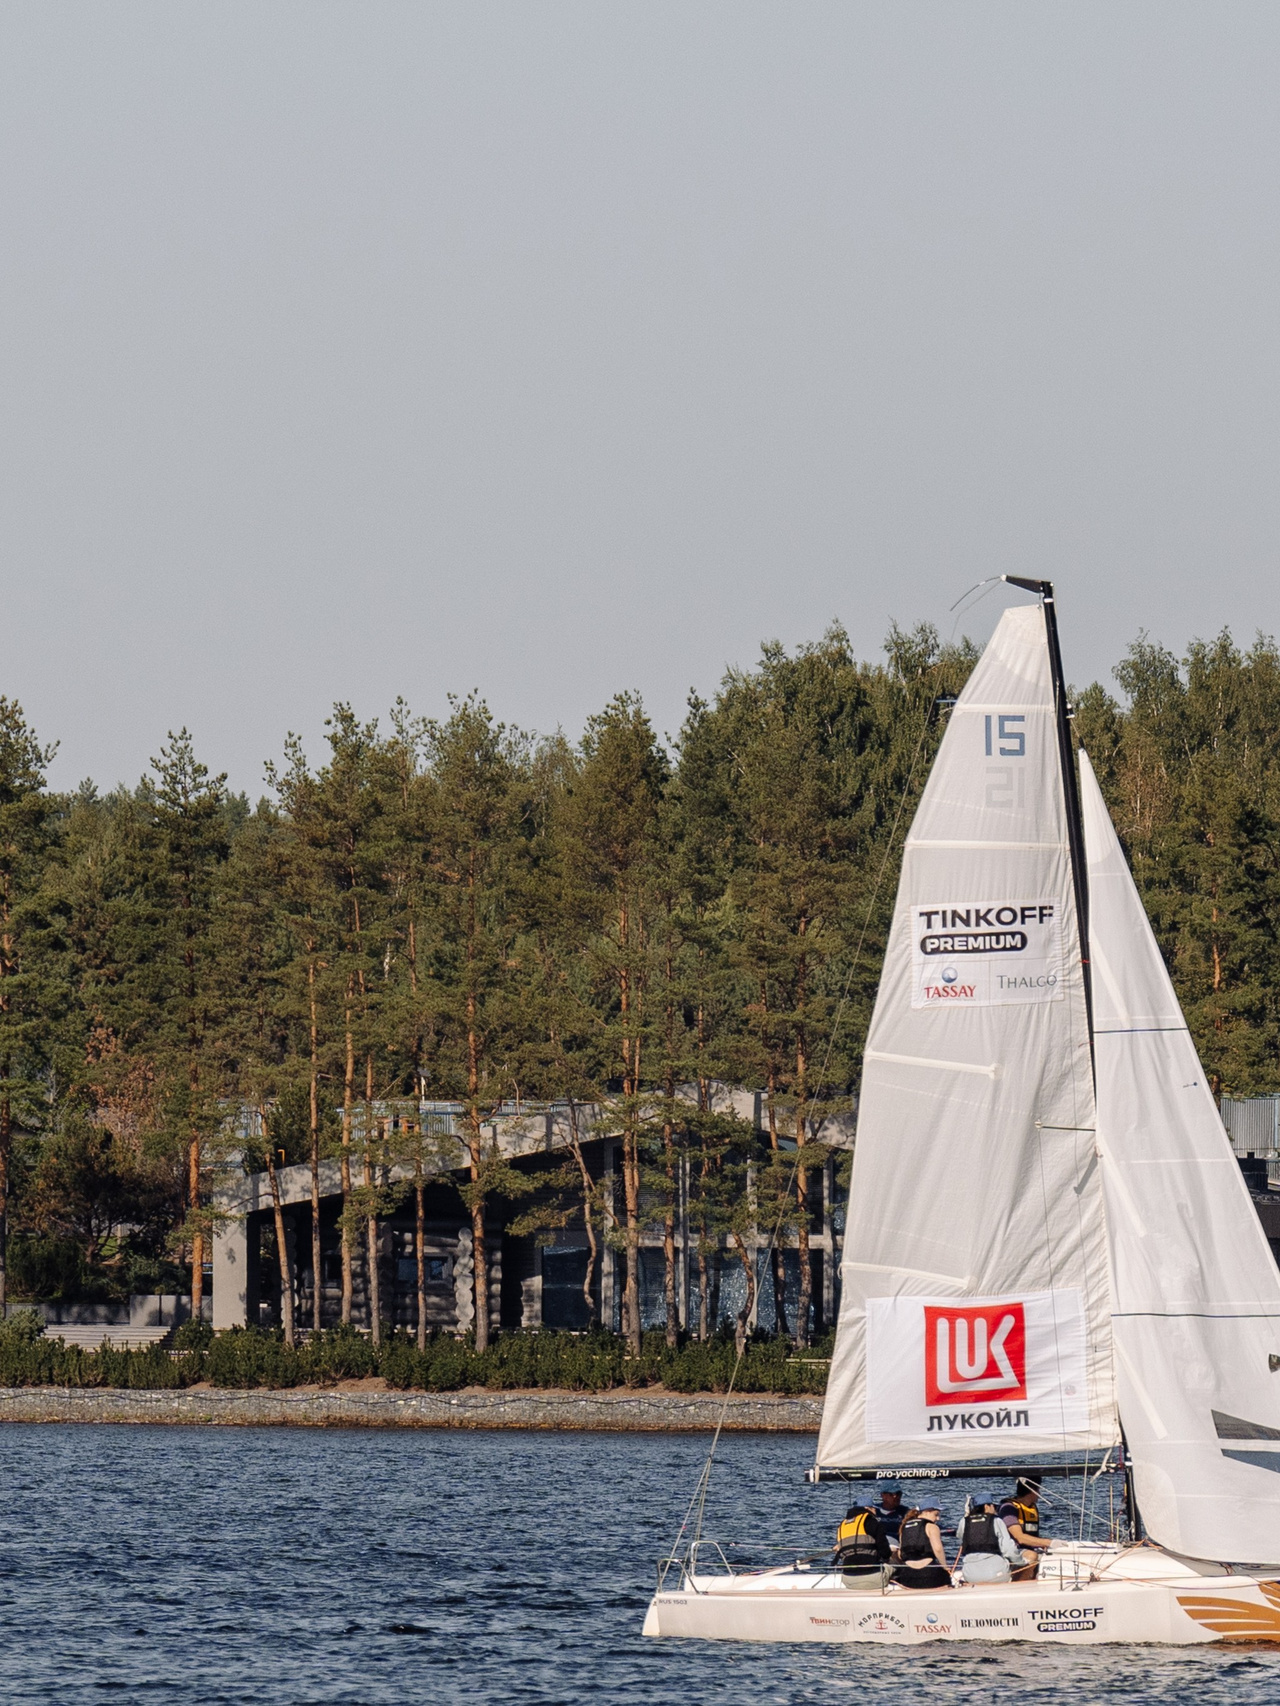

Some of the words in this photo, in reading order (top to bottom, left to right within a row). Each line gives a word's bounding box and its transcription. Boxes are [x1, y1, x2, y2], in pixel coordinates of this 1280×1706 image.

[985, 715, 1025, 756] 15
[919, 905, 1054, 930] TINKOFF
[926, 933, 1022, 952] PREMIUM
[924, 985, 976, 999] TASSAY
[936, 1314, 1020, 1394] LUK
[927, 1408, 1029, 1431] ЛУКОЙЛ
[876, 1468, 949, 1479] pro-yachting.ru
[1027, 1607, 1104, 1620] TINKOFF
[914, 1624, 952, 1633] TASSAY
[960, 1617, 1019, 1628] ВЕДОМОСТИ
[1039, 1621, 1093, 1632] PREMIUM
